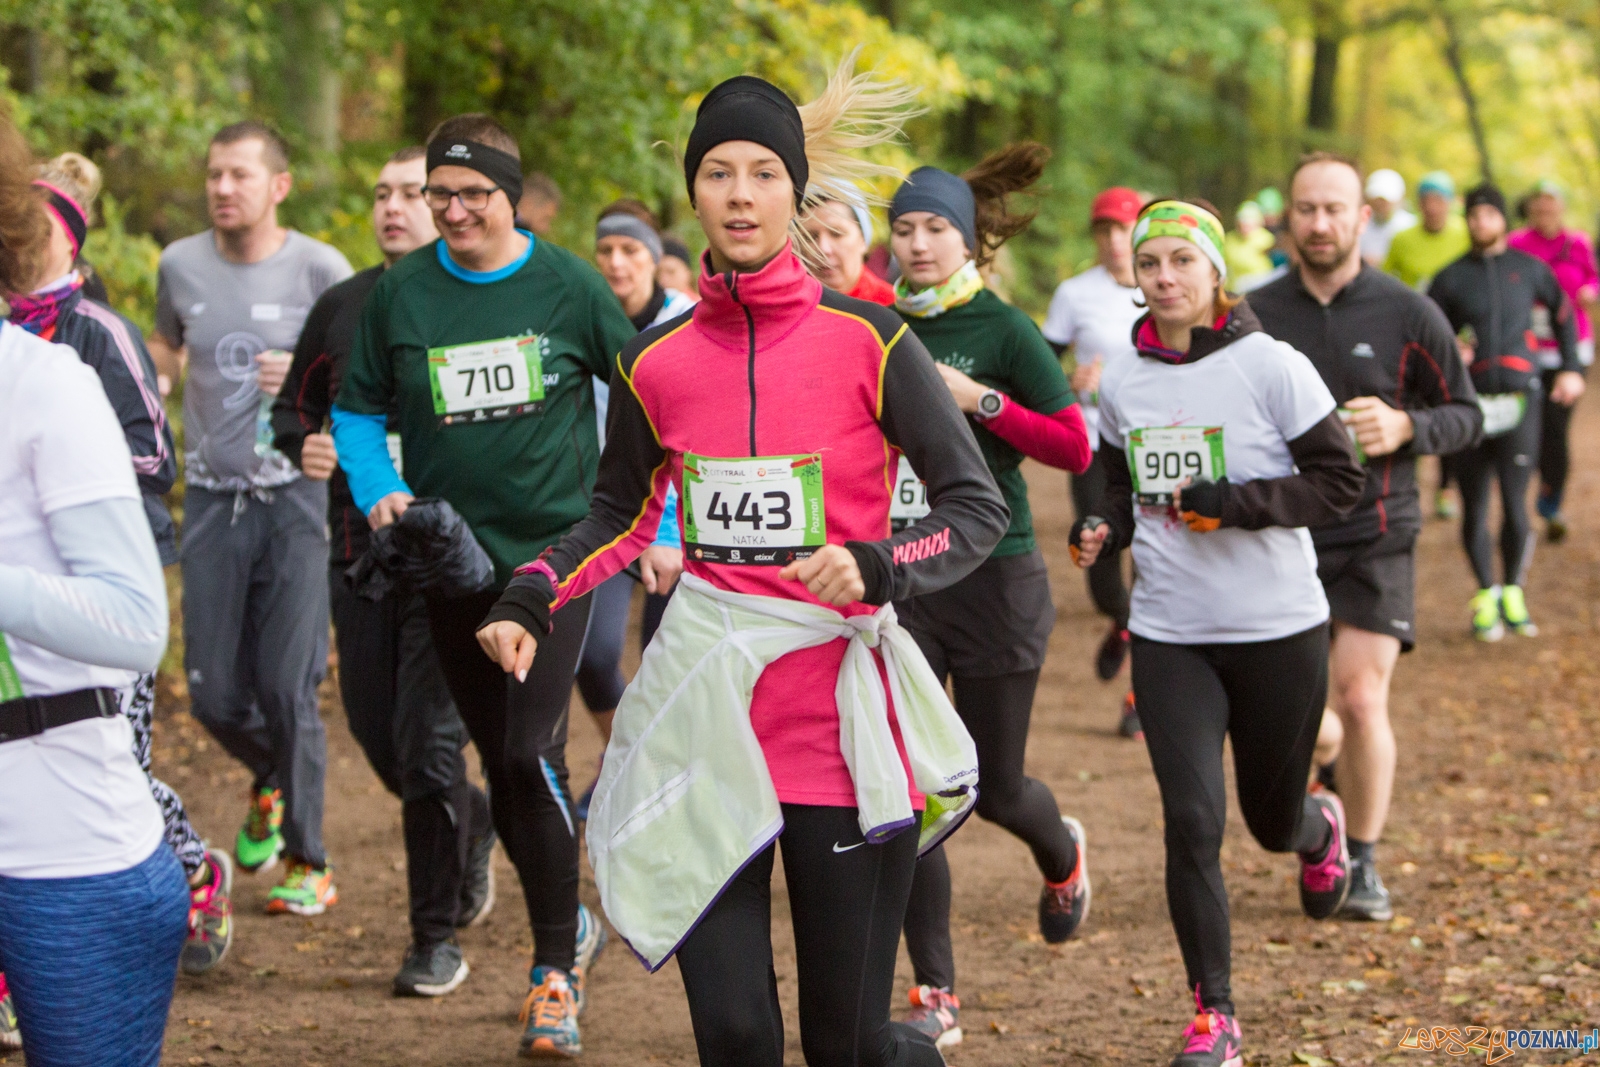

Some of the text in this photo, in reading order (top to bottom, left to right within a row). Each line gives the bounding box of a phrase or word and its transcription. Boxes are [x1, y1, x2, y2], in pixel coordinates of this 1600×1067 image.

[457, 364, 515, 397] 710
[1146, 451, 1203, 480] 909
[706, 490, 792, 531] 443
[810, 497, 820, 534] Poznań
[732, 535, 767, 545] NATKA
